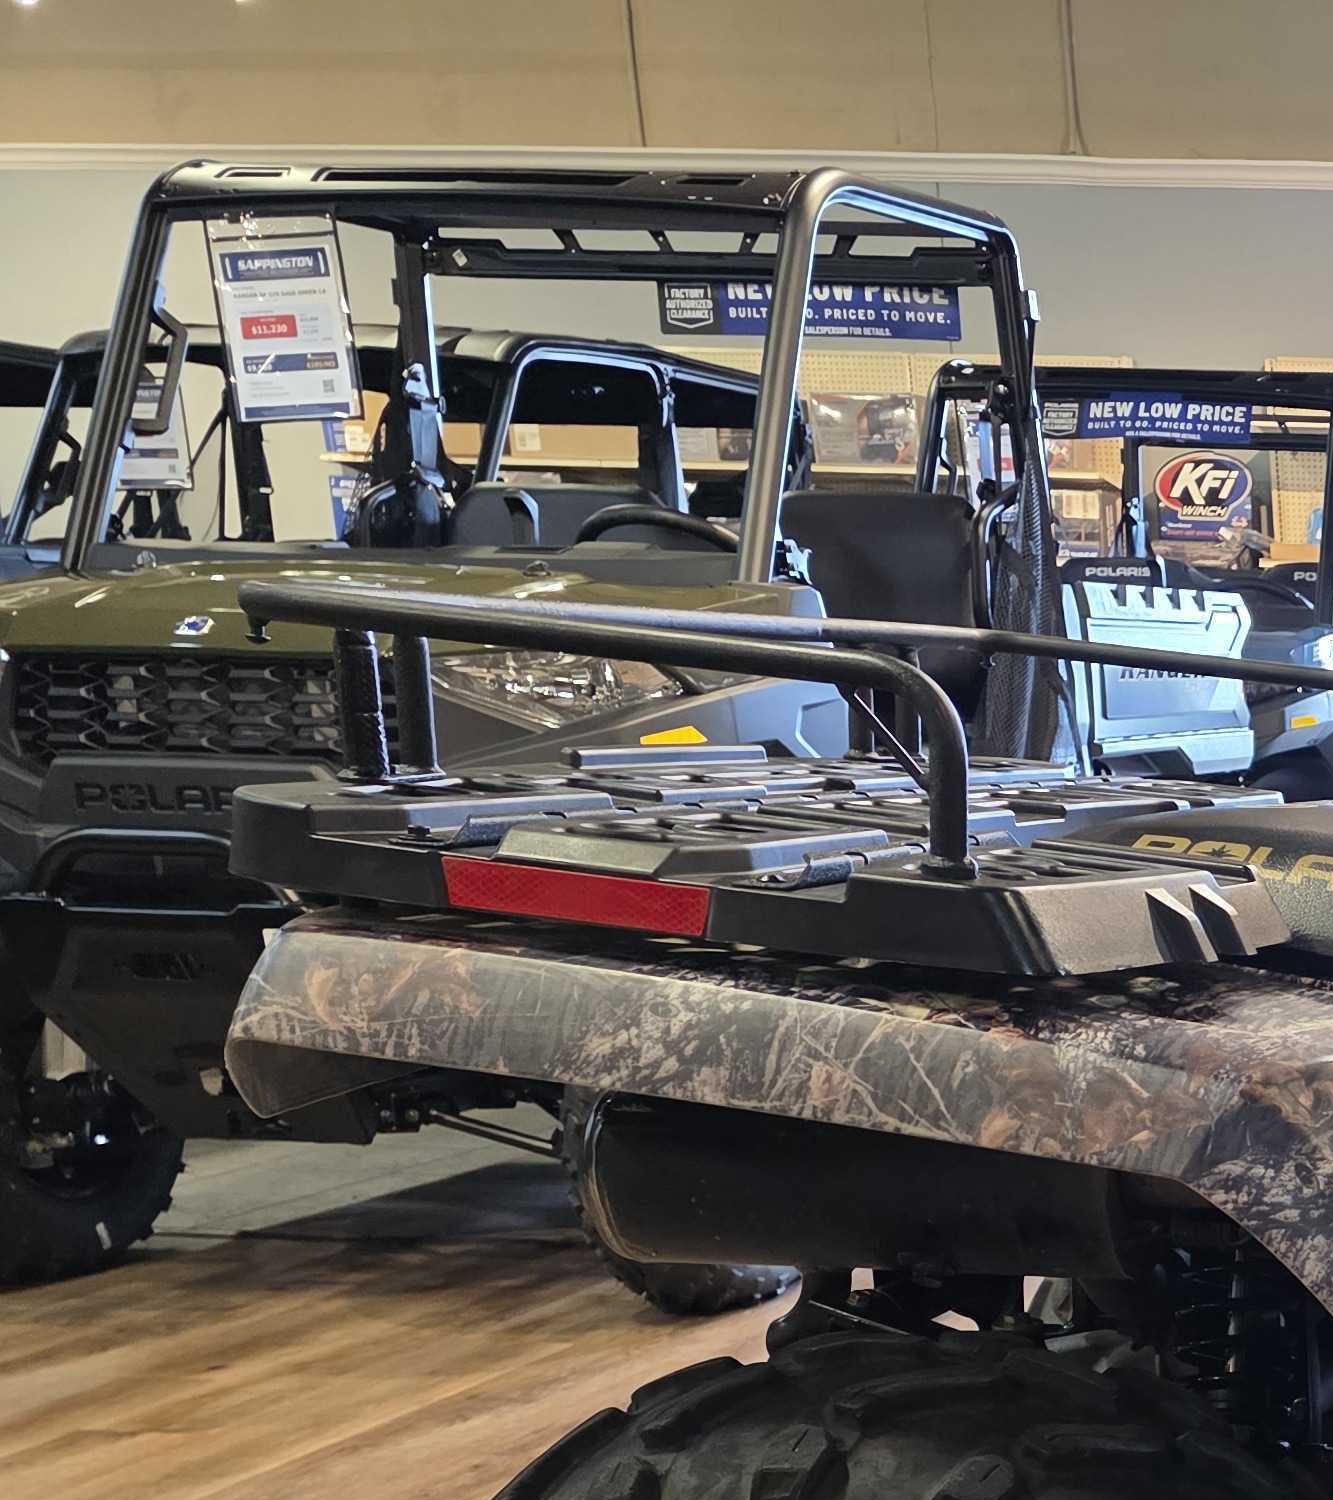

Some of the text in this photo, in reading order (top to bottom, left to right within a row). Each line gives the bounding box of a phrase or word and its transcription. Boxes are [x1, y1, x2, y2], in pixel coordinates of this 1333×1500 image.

[238, 255, 314, 271] SAPPINGTON
[807, 286, 853, 302] OW
[864, 286, 949, 305] PRICE
[729, 308, 951, 324] BUILT O. PRICED TO MOVE.
[1089, 402, 1247, 423] NEW LOW PRICE
[1087, 420, 1116, 429] BUILT
[1119, 420, 1132, 428] TO
[1155, 421, 1193, 430] PRICED
[1196, 424, 1209, 432] TO
[1213, 425, 1245, 434] MOVE.
[1182, 505, 1227, 516] WINCH
[1086, 566, 1151, 577] POLARIS
[74, 783, 232, 813] POLA
